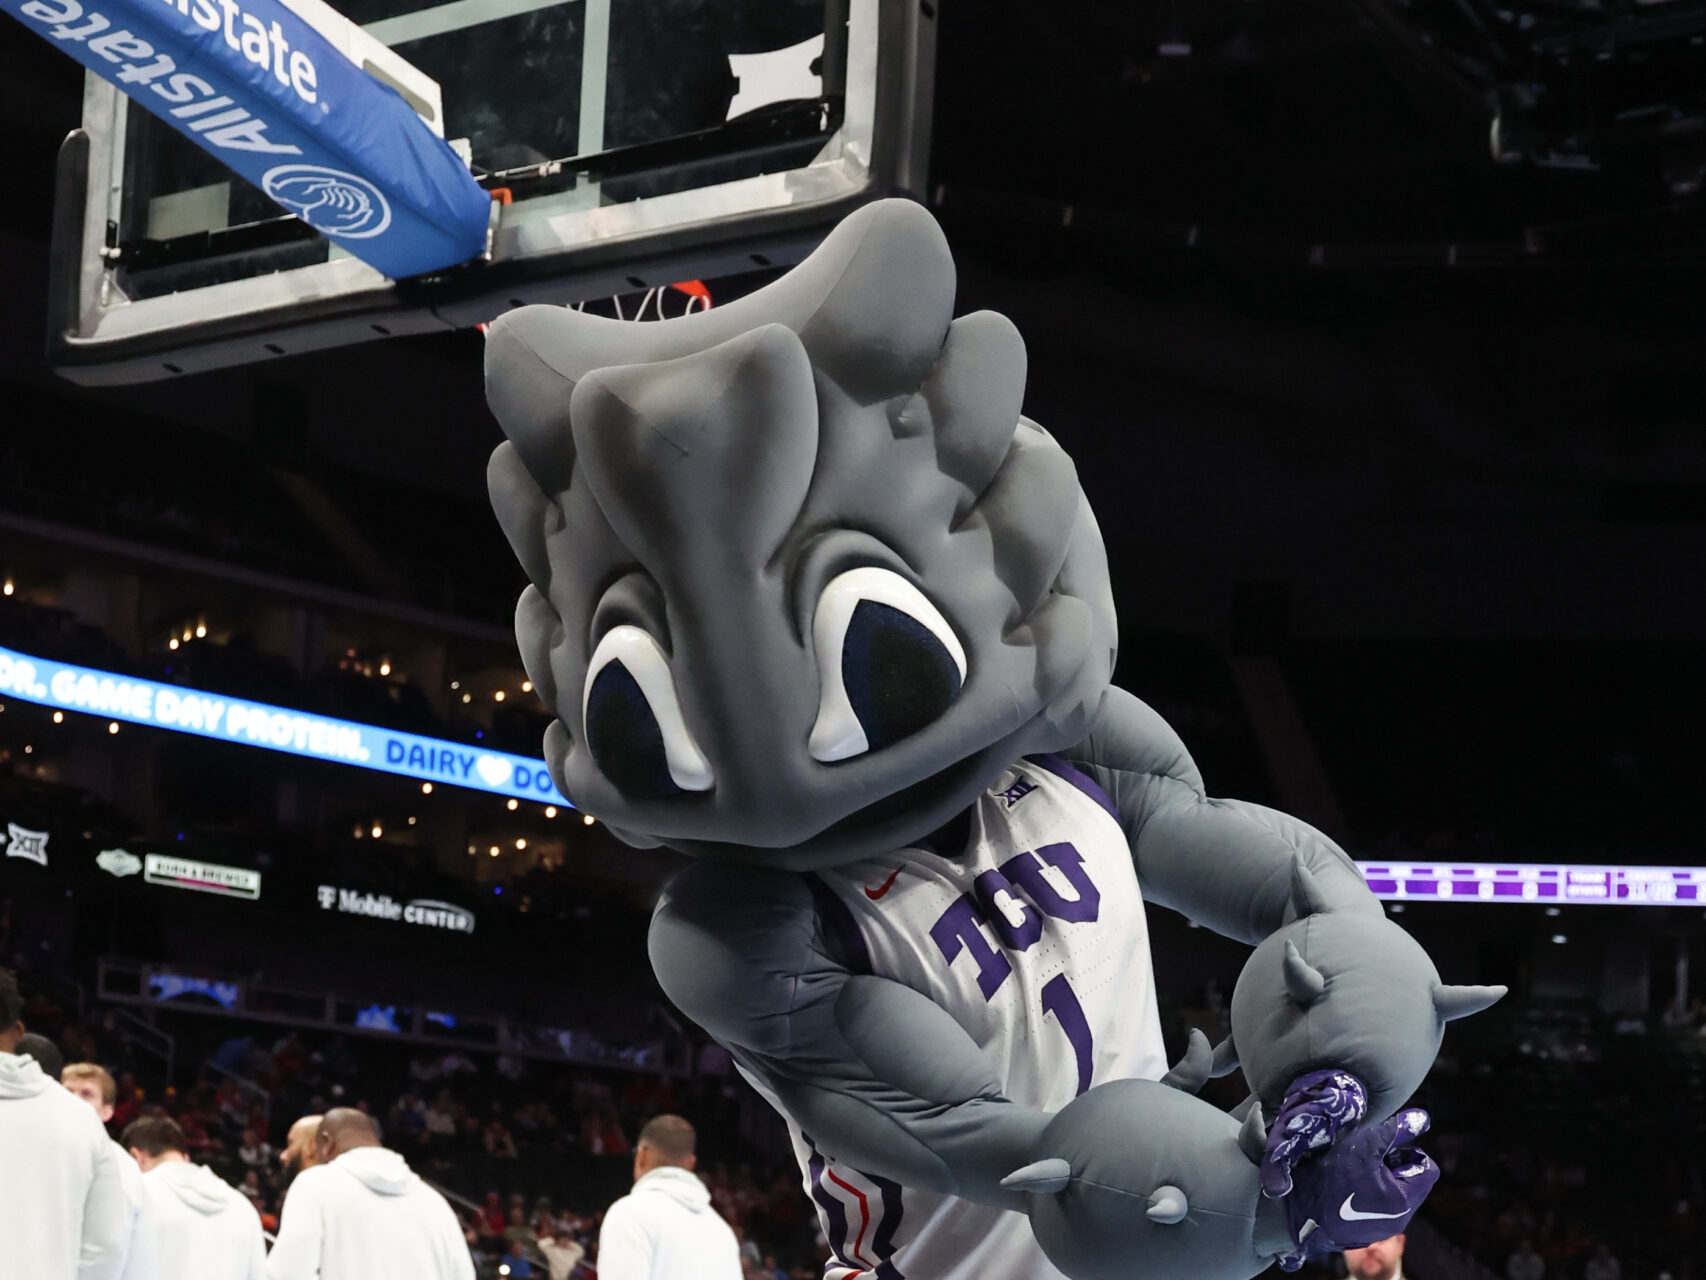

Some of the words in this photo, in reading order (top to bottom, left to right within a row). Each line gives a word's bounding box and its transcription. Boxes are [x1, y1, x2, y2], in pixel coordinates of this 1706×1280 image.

[20, 0, 303, 155] Allstate
[51, 669, 152, 719] GAME
[154, 689, 225, 732] DAY
[226, 704, 370, 762] PROTEIN.
[386, 739, 475, 779] DAIRY
[338, 888, 402, 921] Mobile
[403, 905, 468, 932] CENTER
[929, 841, 1101, 1003] TCU
[1041, 972, 1094, 1098] 1
